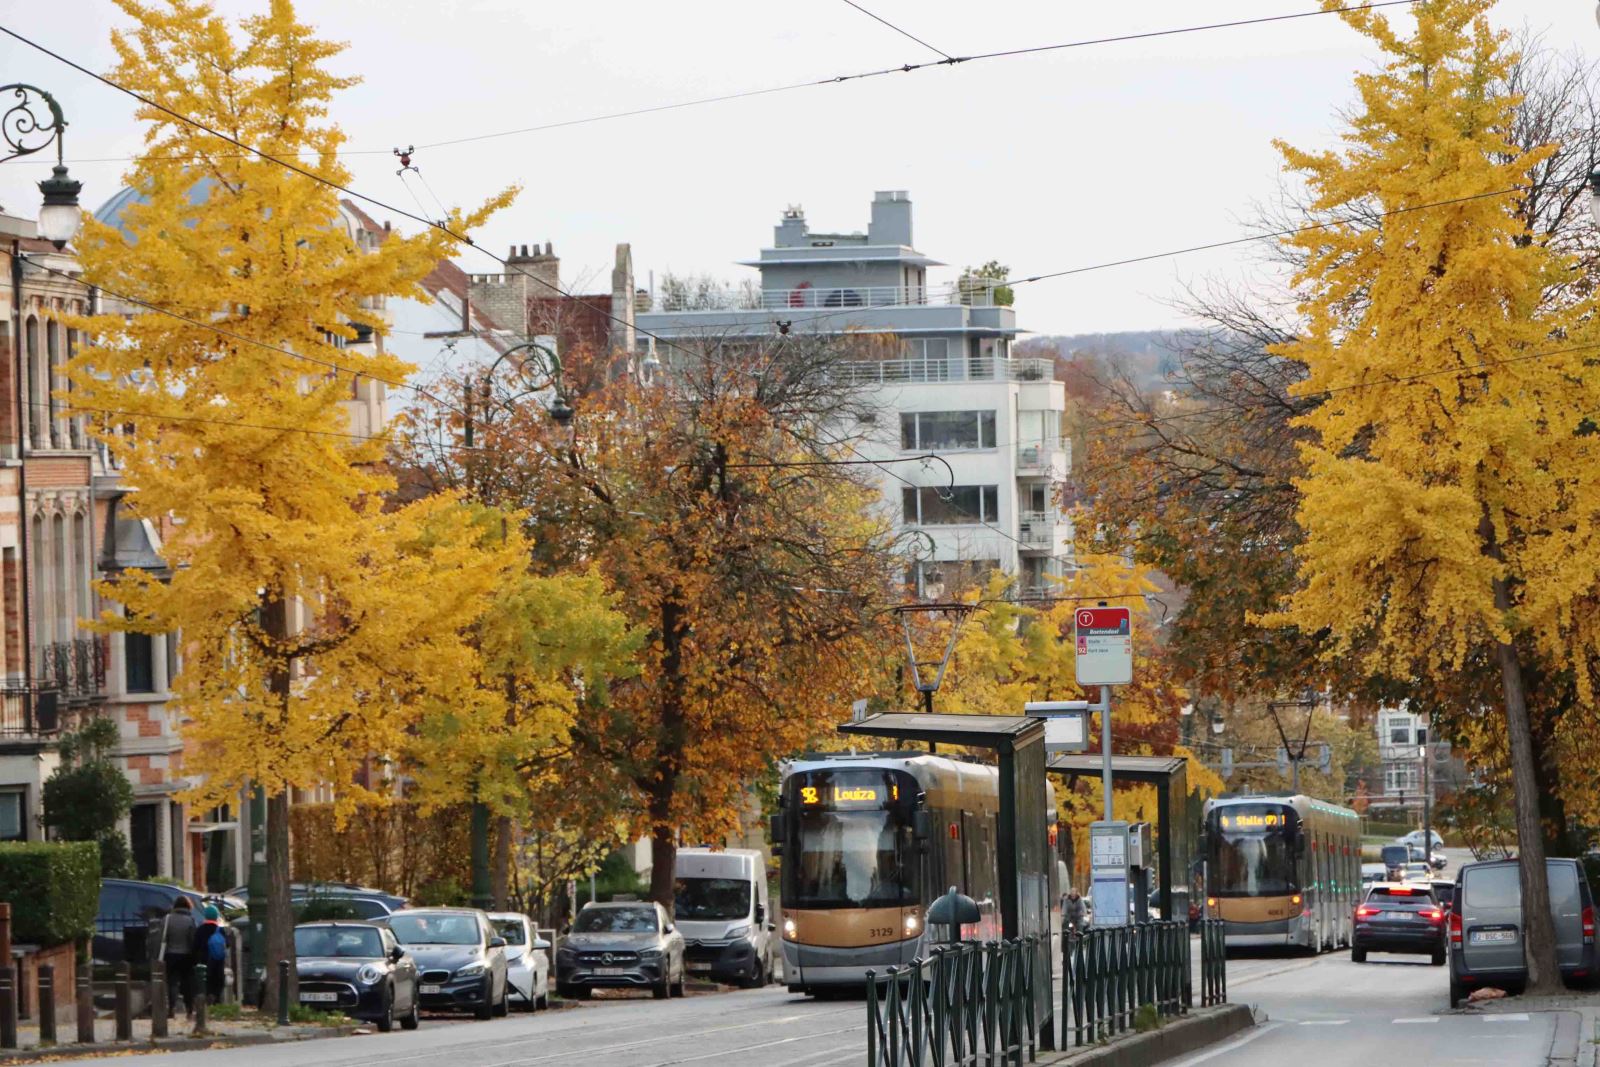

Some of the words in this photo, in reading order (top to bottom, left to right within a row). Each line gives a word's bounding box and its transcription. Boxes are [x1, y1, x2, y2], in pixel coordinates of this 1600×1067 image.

[1083, 614, 1089, 623] T
[834, 786, 876, 801] Louiza
[1236, 815, 1264, 826] Stalle
[870, 927, 893, 937] 3129
